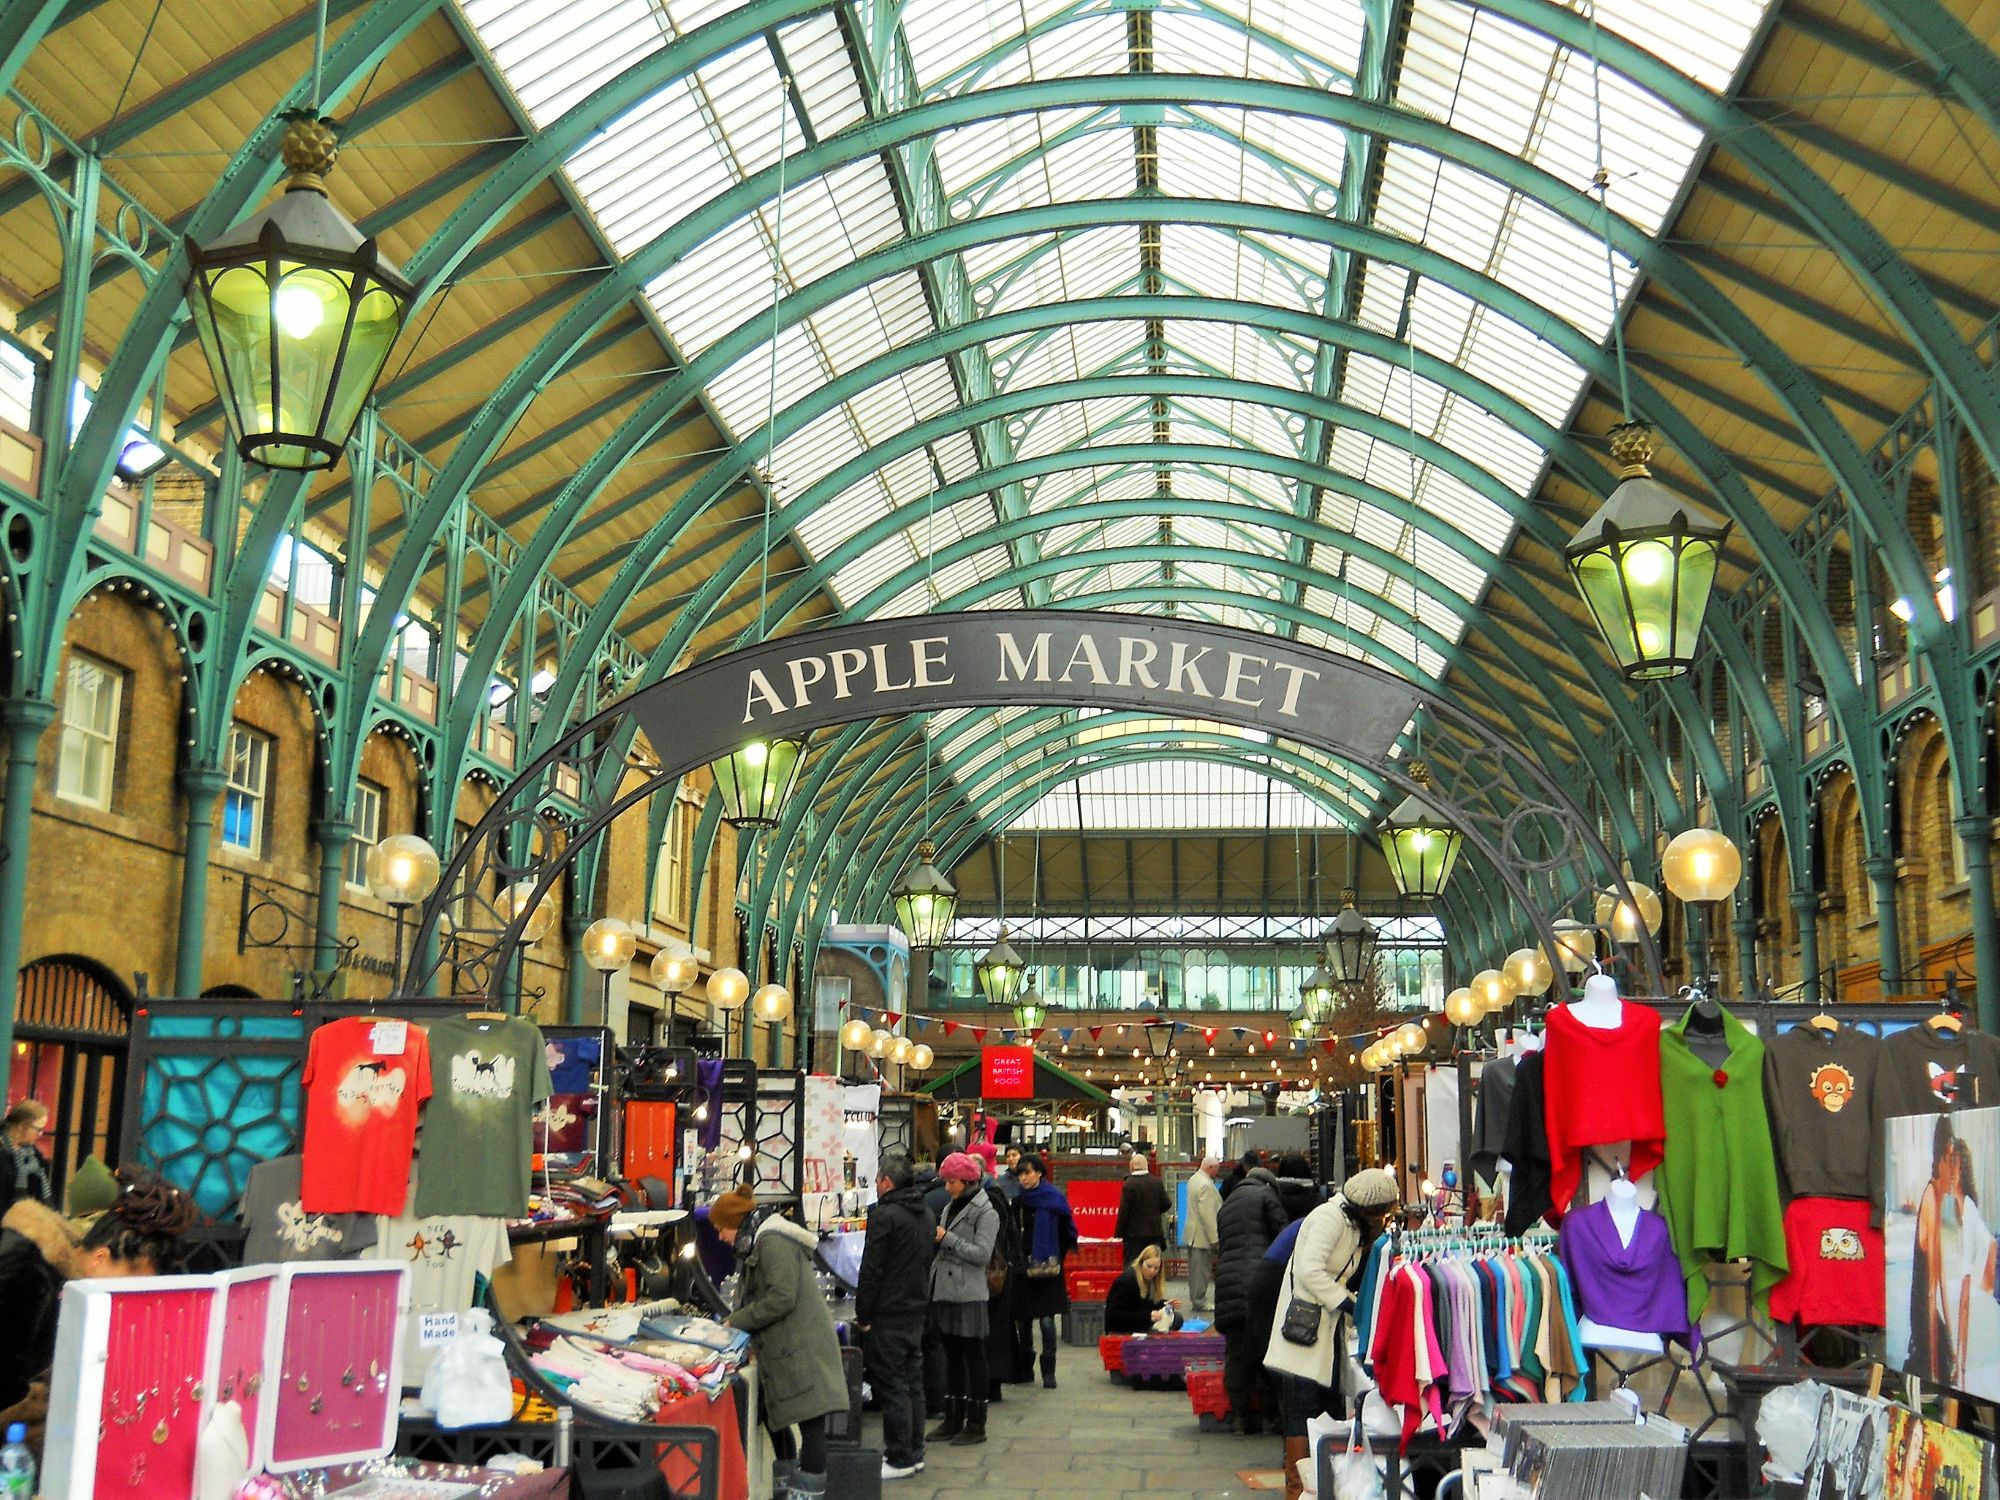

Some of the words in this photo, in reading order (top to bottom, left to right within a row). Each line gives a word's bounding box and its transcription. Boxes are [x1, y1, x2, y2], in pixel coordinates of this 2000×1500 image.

[742, 635, 955, 725] APPLE
[995, 632, 1321, 718] MARKET
[994, 1058, 1021, 1066] GREAT
[424, 1314, 456, 1327] Hand
[423, 1328, 456, 1339] Made
